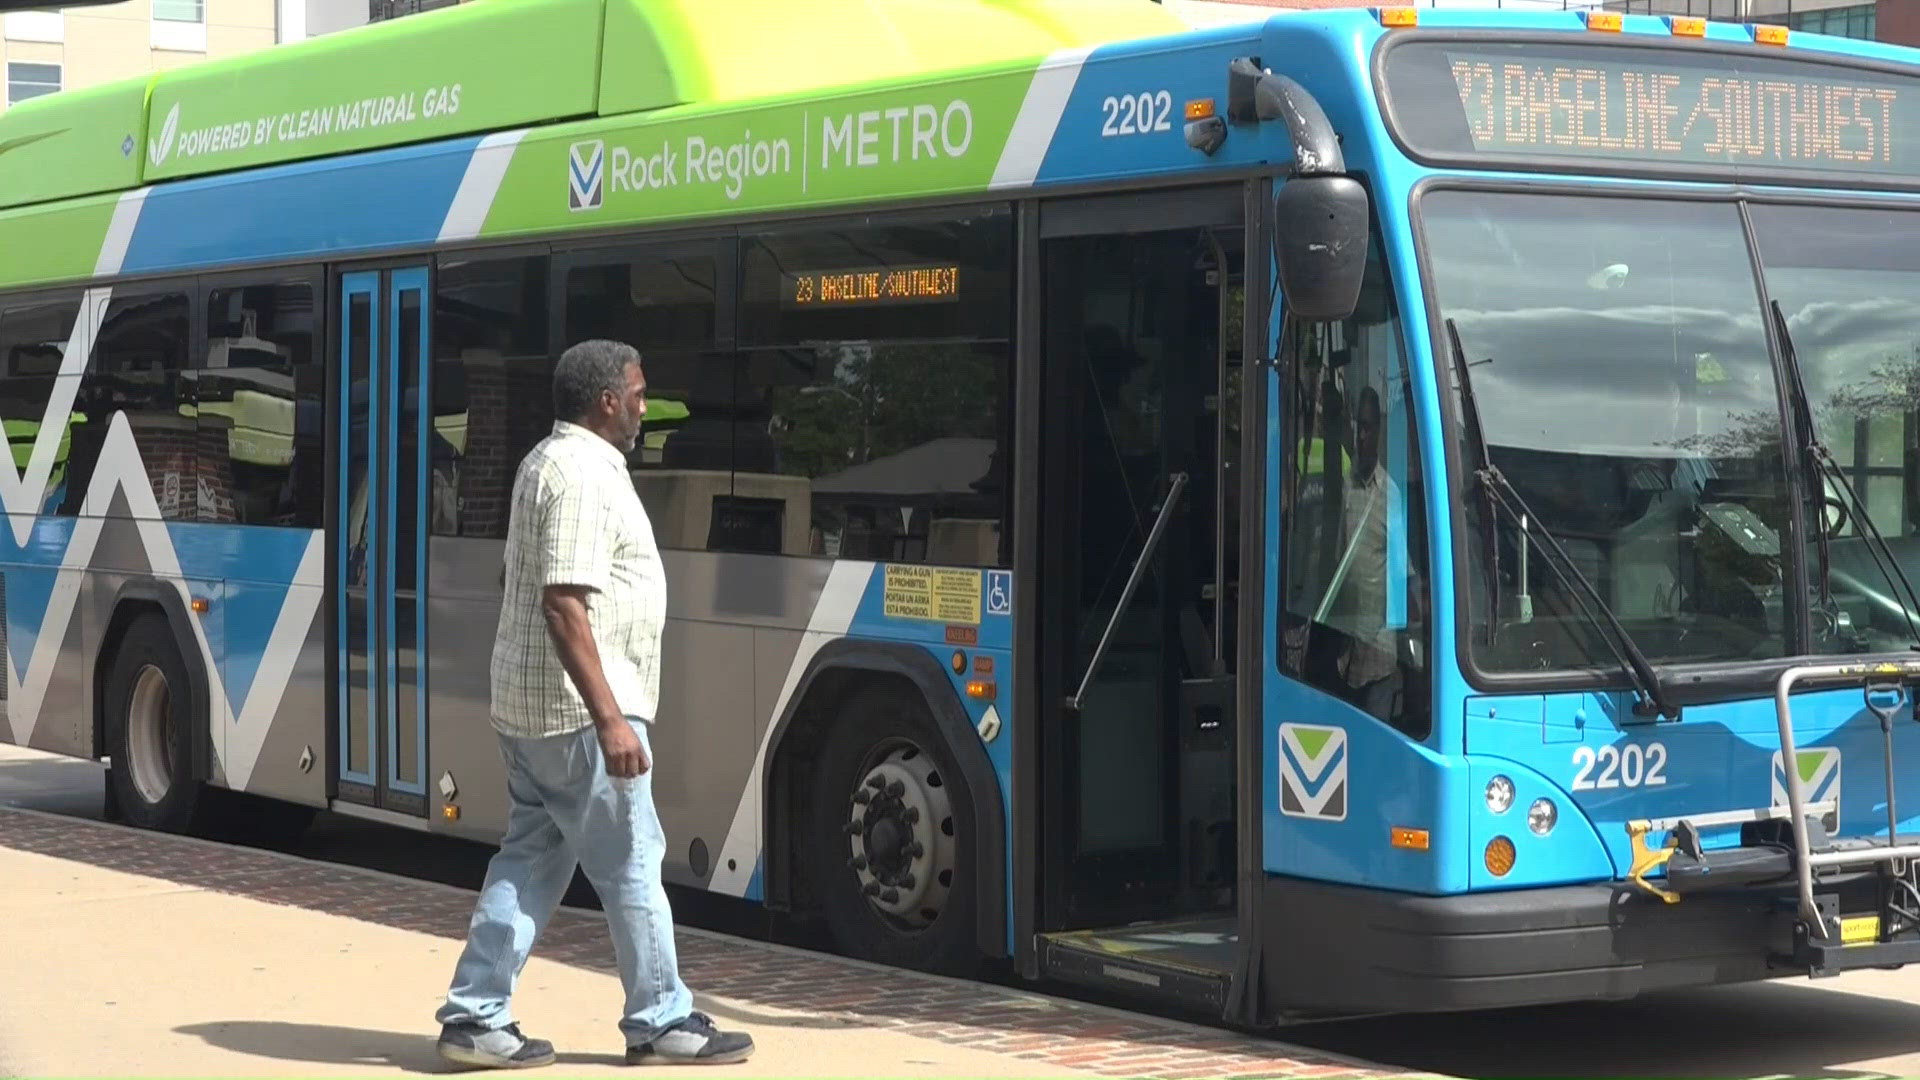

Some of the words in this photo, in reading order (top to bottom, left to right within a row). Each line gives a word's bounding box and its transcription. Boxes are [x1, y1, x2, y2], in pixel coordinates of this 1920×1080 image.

[177, 120, 251, 158] POWERED
[254, 115, 276, 145] BY
[278, 106, 333, 142] CLEAN
[335, 91, 416, 132] NATURAL
[422, 82, 462, 119] GAS
[1102, 90, 1172, 137] 2202
[1504, 64, 1897, 161] BASELINE/SOUTHWEST
[611, 141, 678, 193] Rock
[686, 130, 790, 201] Region
[822, 99, 973, 169] METRO
[796, 276, 813, 301] 23
[821, 267, 957, 301] BASELINE/SOUTHWEST
[918, 568, 931, 577] GUN
[1572, 742, 1667, 791] 2202
